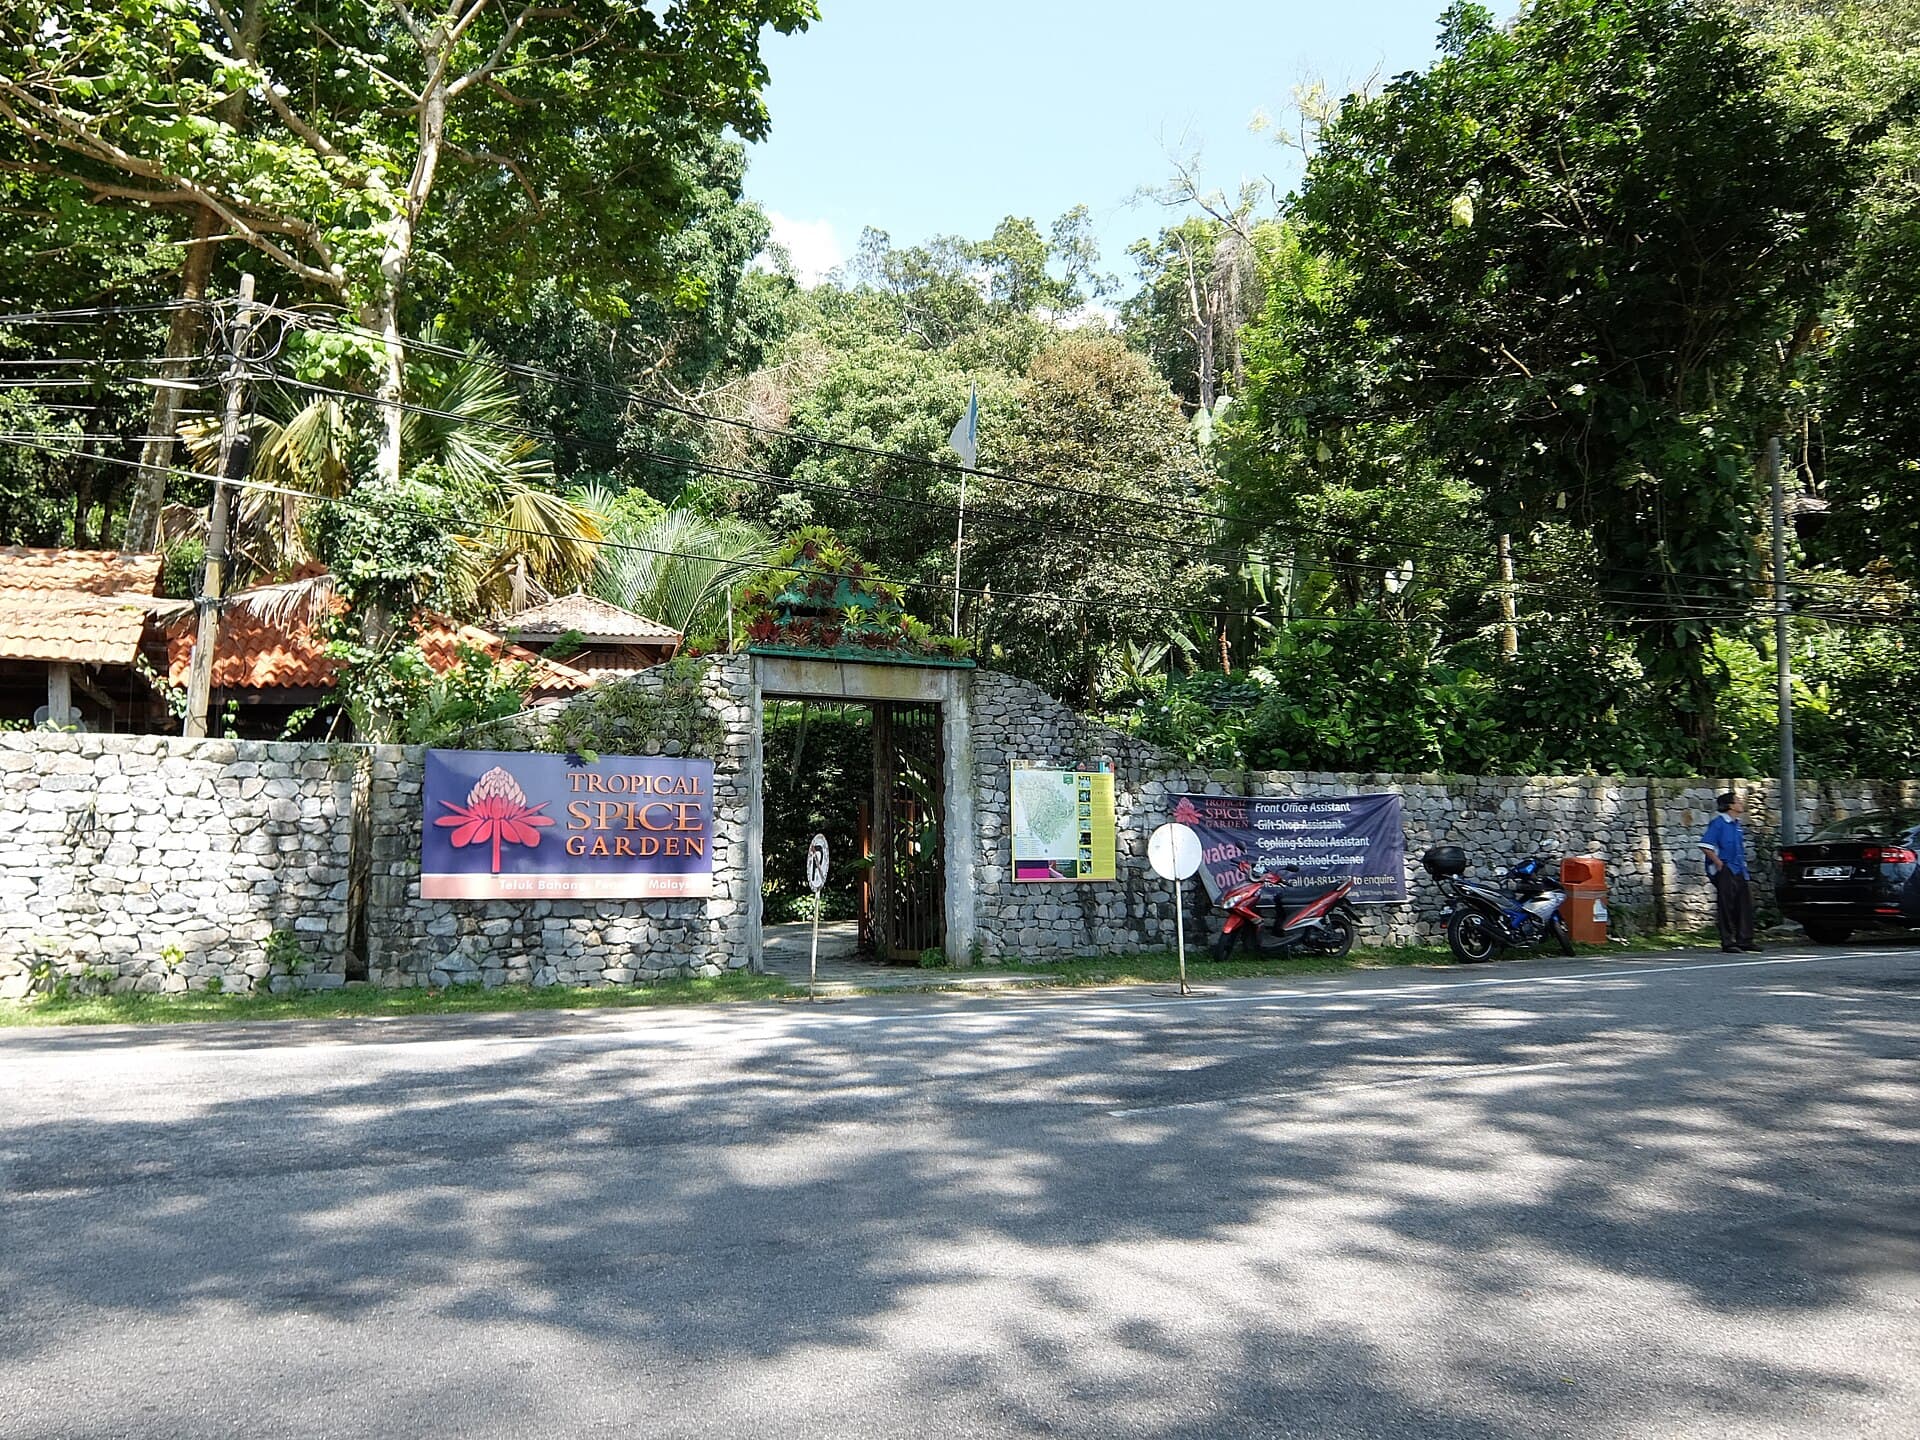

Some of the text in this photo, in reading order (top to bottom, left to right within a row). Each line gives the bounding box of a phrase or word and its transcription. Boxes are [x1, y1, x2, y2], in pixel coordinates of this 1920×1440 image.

[567, 773, 705, 795] TROPICAL
[1205, 808, 1248, 819] SPICE
[1255, 802, 1351, 813] Front Office Assistant
[566, 800, 704, 831] SPICE
[1205, 820, 1248, 828] GARDEN
[1257, 820, 1275, 830] Gift
[1276, 820, 1300, 832] Shop
[566, 836, 705, 858] GARDEN
[1257, 836, 1370, 851] Cooking School Assistant
[1298, 854, 1329, 865] School
[1330, 854, 1364, 865] Cleaner
[499, 879, 533, 890] Teluk
[1353, 876, 1363, 885] to
[1364, 874, 1397, 886] enquire.
